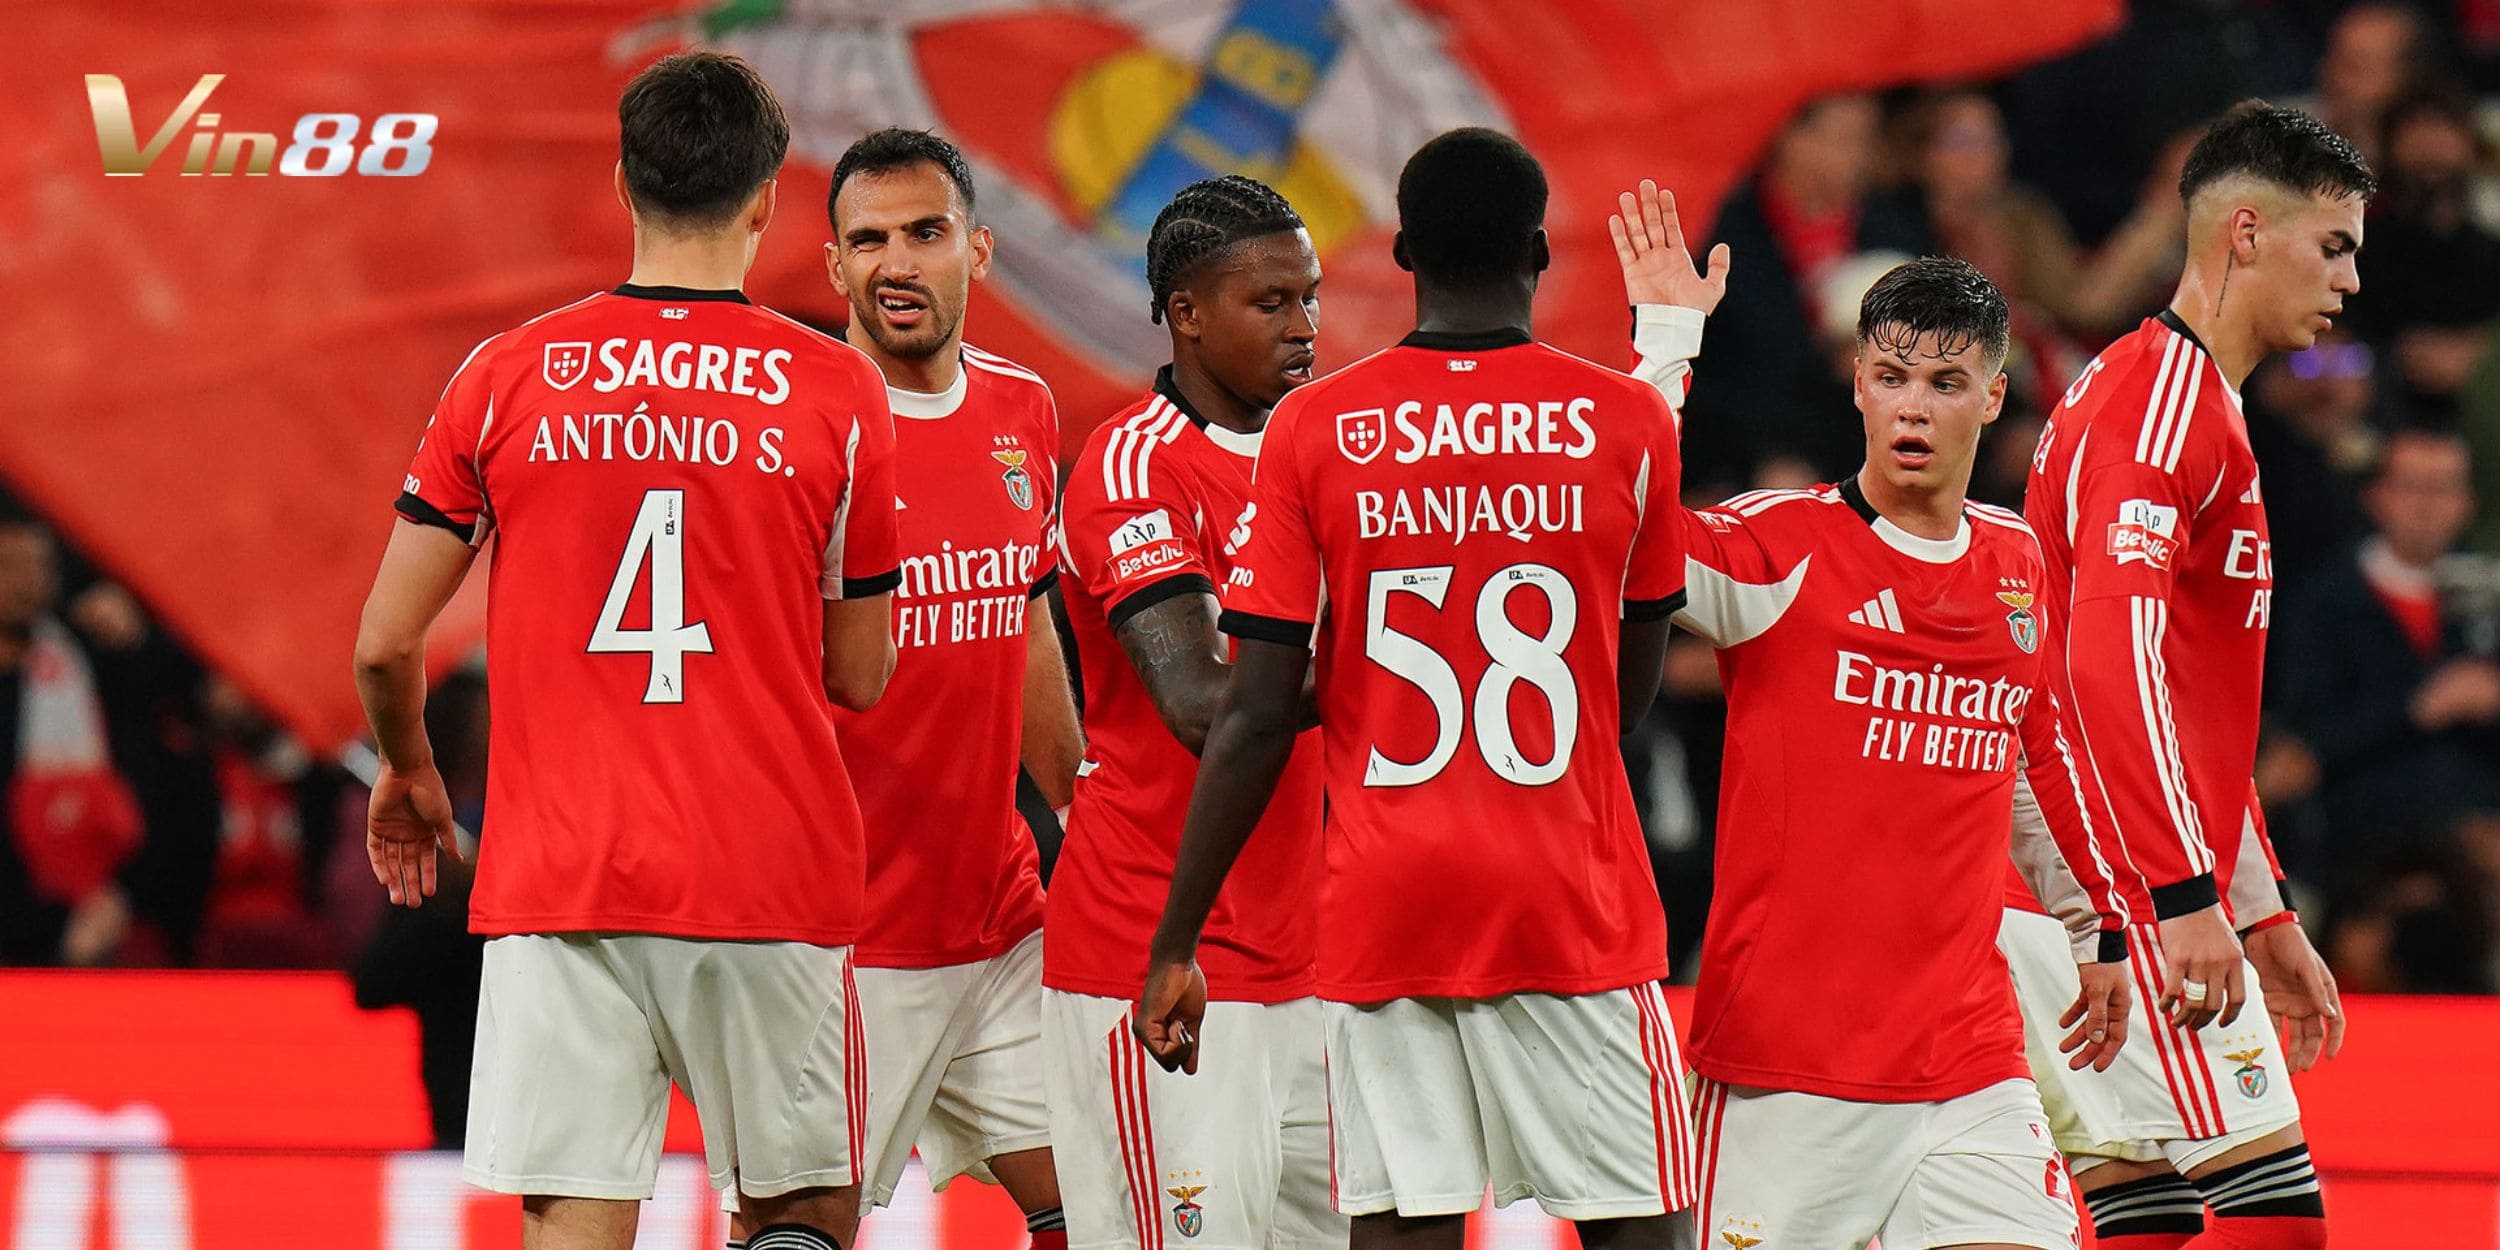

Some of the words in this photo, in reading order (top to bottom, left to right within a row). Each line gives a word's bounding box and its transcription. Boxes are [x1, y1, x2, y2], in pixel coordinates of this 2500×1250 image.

[593, 338, 792, 405] SAGRES
[528, 401, 739, 466] ANTÓNIO
[756, 427, 795, 477] S.
[1394, 397, 1597, 464] SAGRES
[1356, 483, 1583, 546] BANJAQUI
[585, 489, 716, 704] 4
[893, 539, 1039, 599] mirate
[898, 604, 941, 649] FLY
[951, 594, 1026, 643] BETTER
[1362, 562, 1580, 788] 58
[1862, 717, 1915, 762] FLY
[1922, 725, 2009, 772] BETTER
